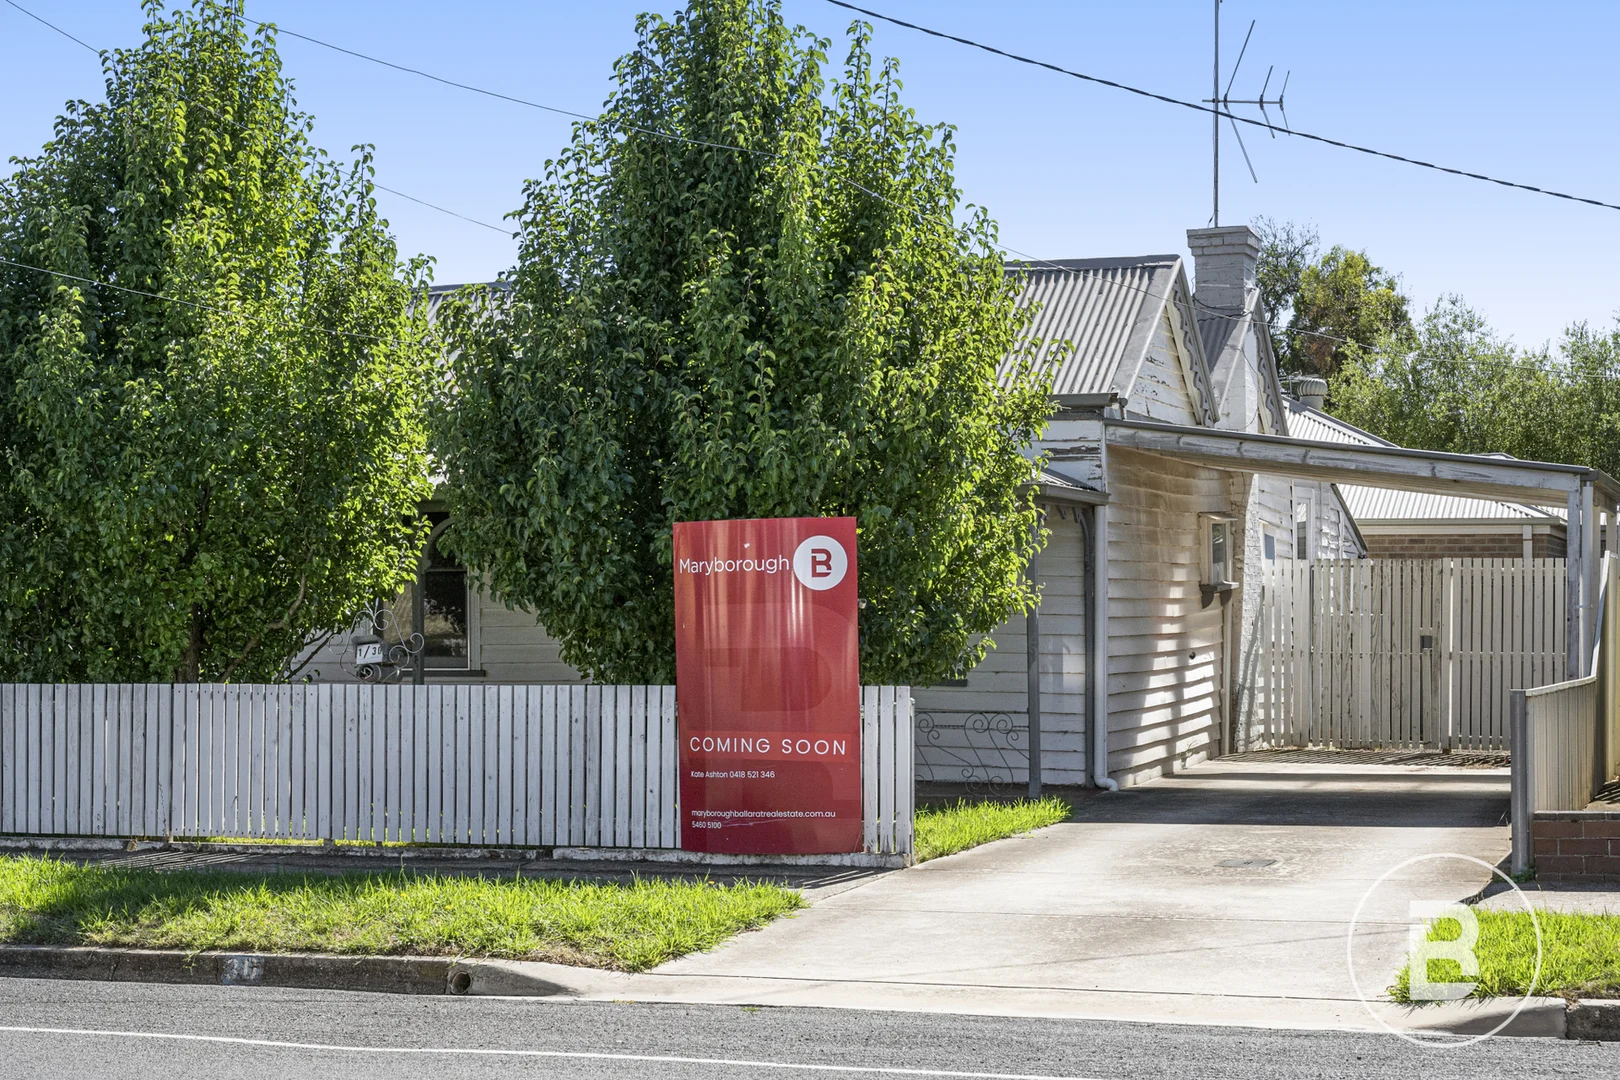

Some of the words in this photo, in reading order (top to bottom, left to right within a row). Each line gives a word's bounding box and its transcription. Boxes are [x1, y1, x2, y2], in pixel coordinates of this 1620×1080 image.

[679, 555, 790, 576] Maryborough
[689, 736, 771, 753] COMING
[781, 739, 846, 755] SOON
[690, 770, 704, 778] Kate
[705, 770, 728, 778] Ashton
[729, 770, 746, 778] 0418
[747, 770, 759, 779] 521
[760, 770, 775, 779] 346
[691, 809, 836, 819] maryboroughballaratrealestate.com.au
[691, 820, 706, 829] 5460
[707, 820, 722, 829] 5100
